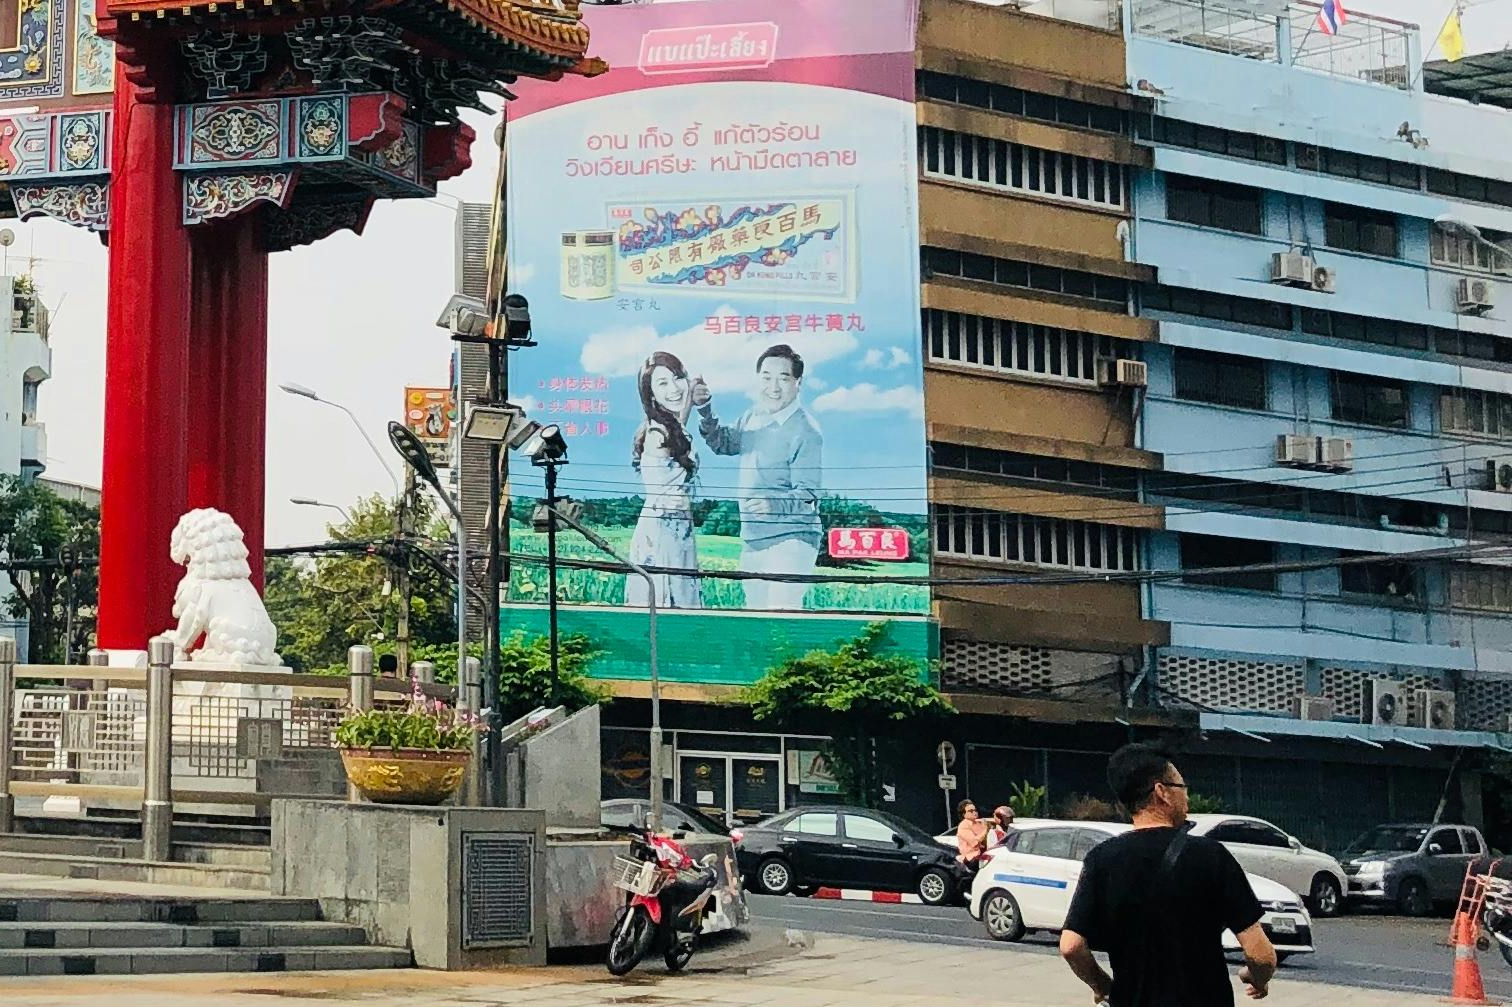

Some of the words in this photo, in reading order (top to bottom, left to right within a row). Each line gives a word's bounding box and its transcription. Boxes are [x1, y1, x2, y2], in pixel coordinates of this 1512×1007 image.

[587, 132, 629, 151] อาน
[638, 126, 673, 149] เก็ง
[713, 121, 820, 146] แก้ตัวร้อน
[710, 148, 857, 172] หน้ามืดตาลาย
